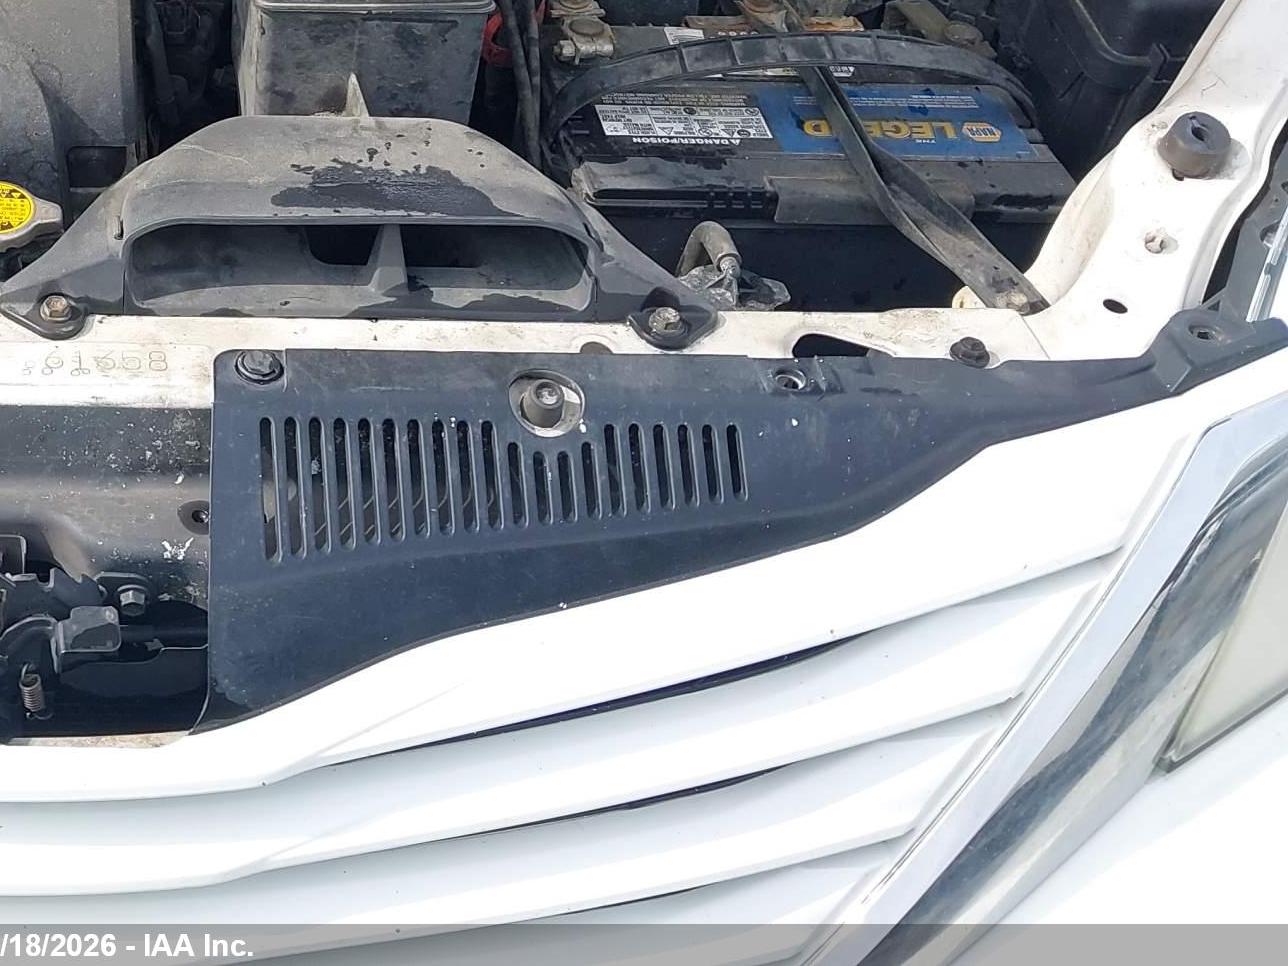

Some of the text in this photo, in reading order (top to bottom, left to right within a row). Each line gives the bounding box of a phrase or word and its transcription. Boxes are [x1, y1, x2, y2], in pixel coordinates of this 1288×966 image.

[803, 119, 958, 139] LEGED
[966, 126, 998, 138] NAPA
[632, 137, 730, 145] DANGER/POISON
